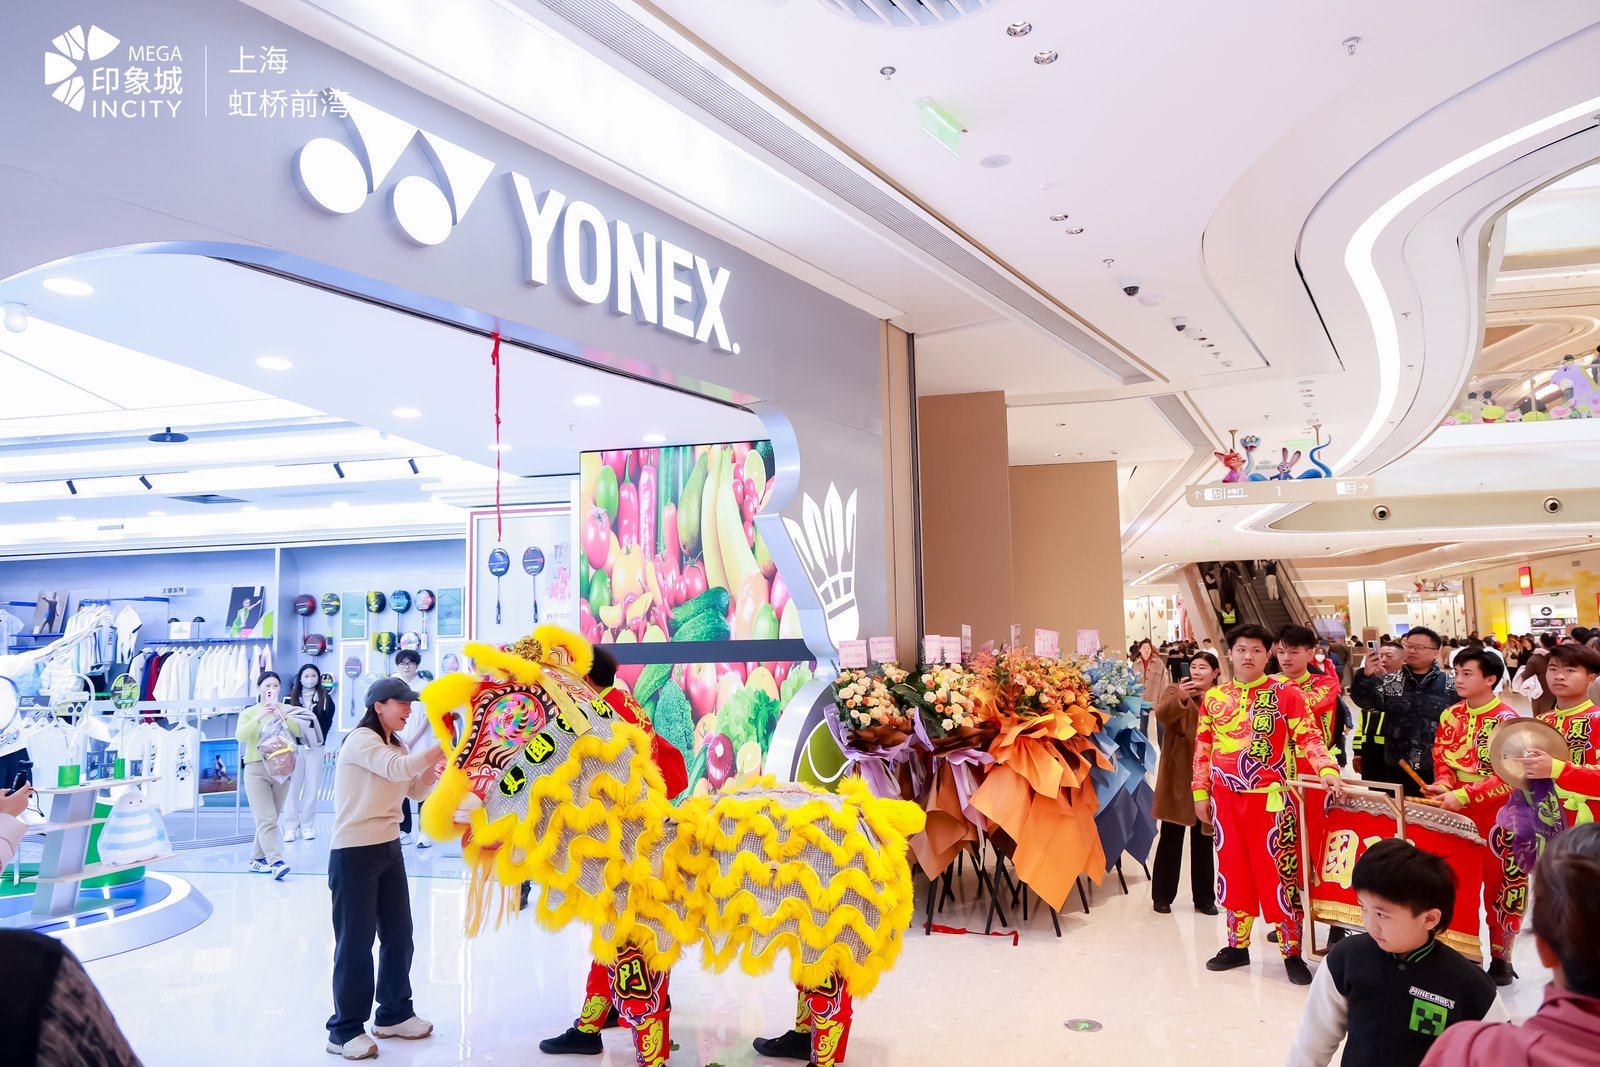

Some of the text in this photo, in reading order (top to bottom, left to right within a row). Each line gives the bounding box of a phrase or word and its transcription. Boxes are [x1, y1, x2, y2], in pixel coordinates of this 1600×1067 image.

[1250, 689, 1278, 764] 夏國璋
[619, 959, 647, 992] 門
[1409, 986, 1456, 1010] MINECRAFT
